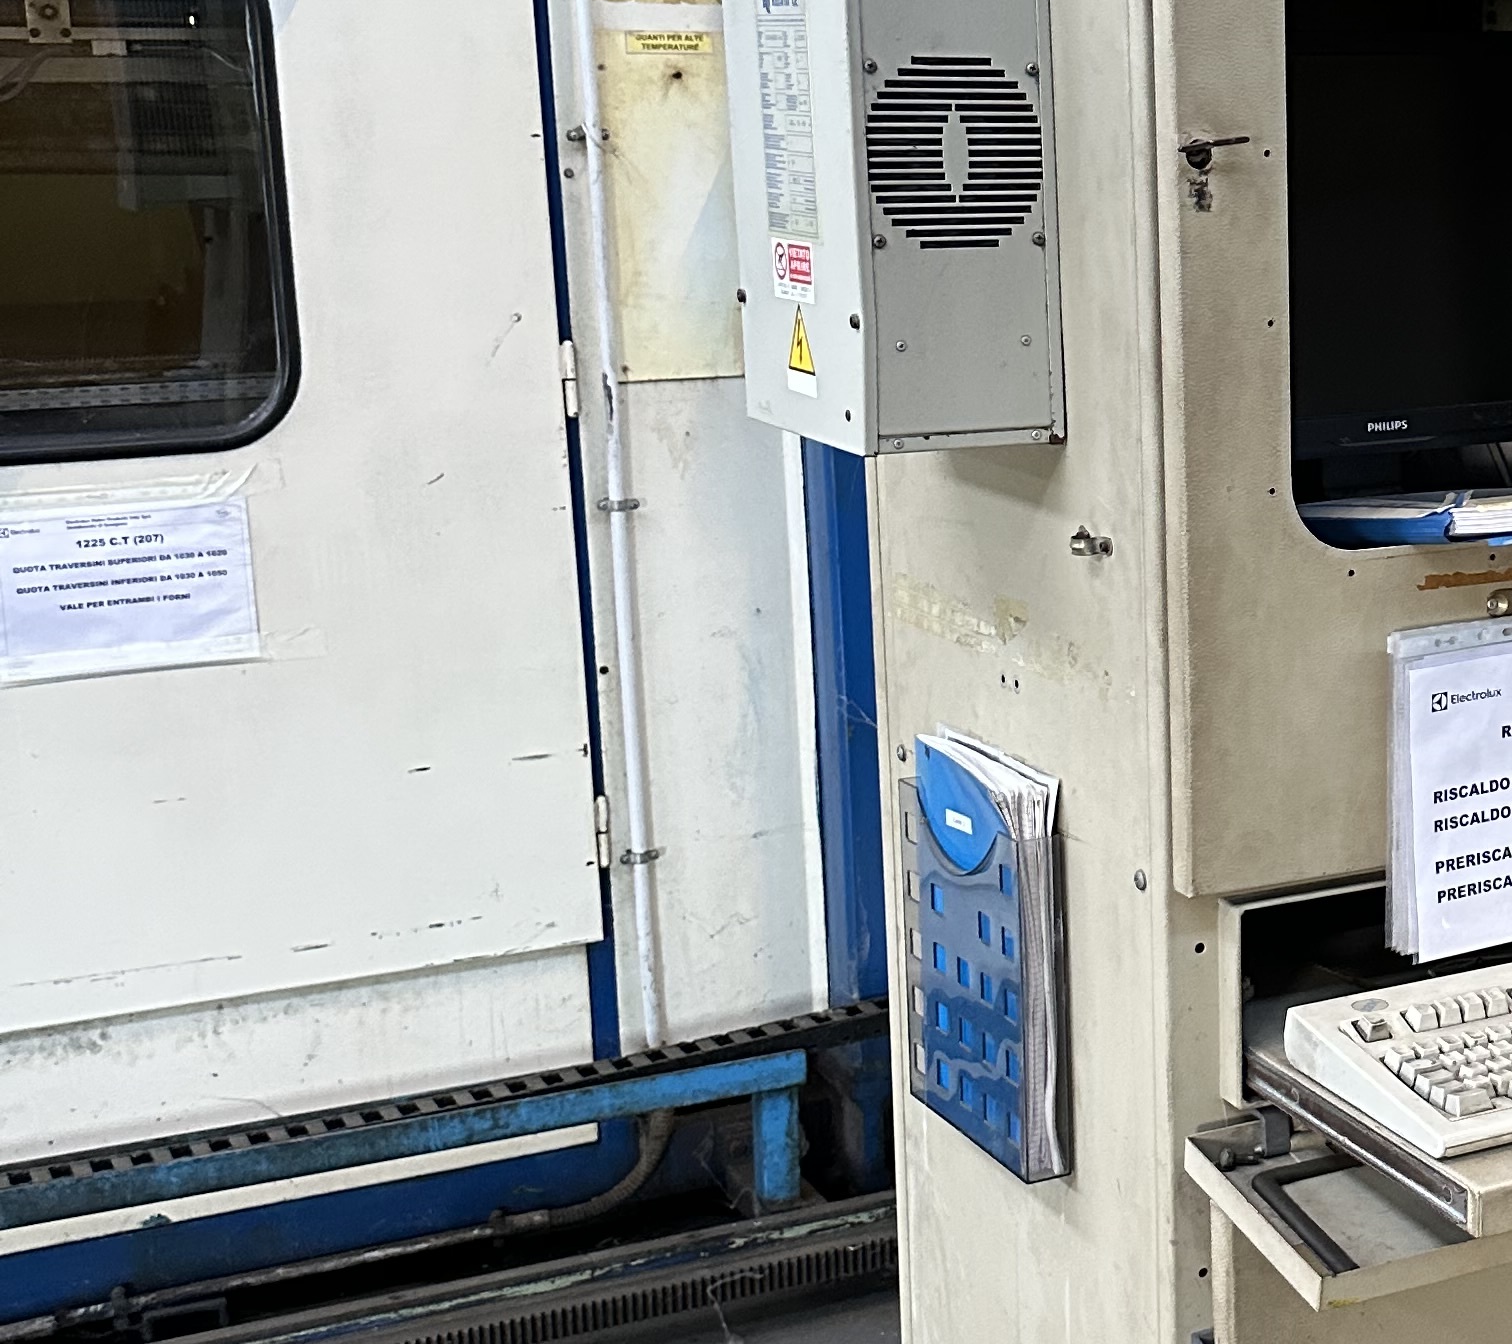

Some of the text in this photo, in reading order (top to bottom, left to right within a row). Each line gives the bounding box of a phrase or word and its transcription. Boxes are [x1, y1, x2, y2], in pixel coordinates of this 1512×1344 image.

[1367, 420, 1408, 432] PHILIPS
[75, 533, 165, 549] 1225 C.T (207)
[12, 563, 47, 574] QUOTA
[49, 560, 106, 571] TRAVERSINI
[107, 556, 157, 566] SUPERIORI
[159, 554, 172, 562] DA
[16, 584, 50, 595] QUOTA
[53, 580, 109, 592] TRAVERSINI
[111, 576, 158, 586] INFERIORI
[160, 574, 173, 582] DA
[59, 601, 84, 611] VALE
[86, 600, 105, 609] PER
[106, 596, 155, 607] ENTRAMBI
[163, 593, 191, 602] FORNI
[1450, 687, 1502, 706] Electrolux
[1433, 777, 1511, 804] RISCALDO
[1433, 805, 1511, 833] RISCALDO
